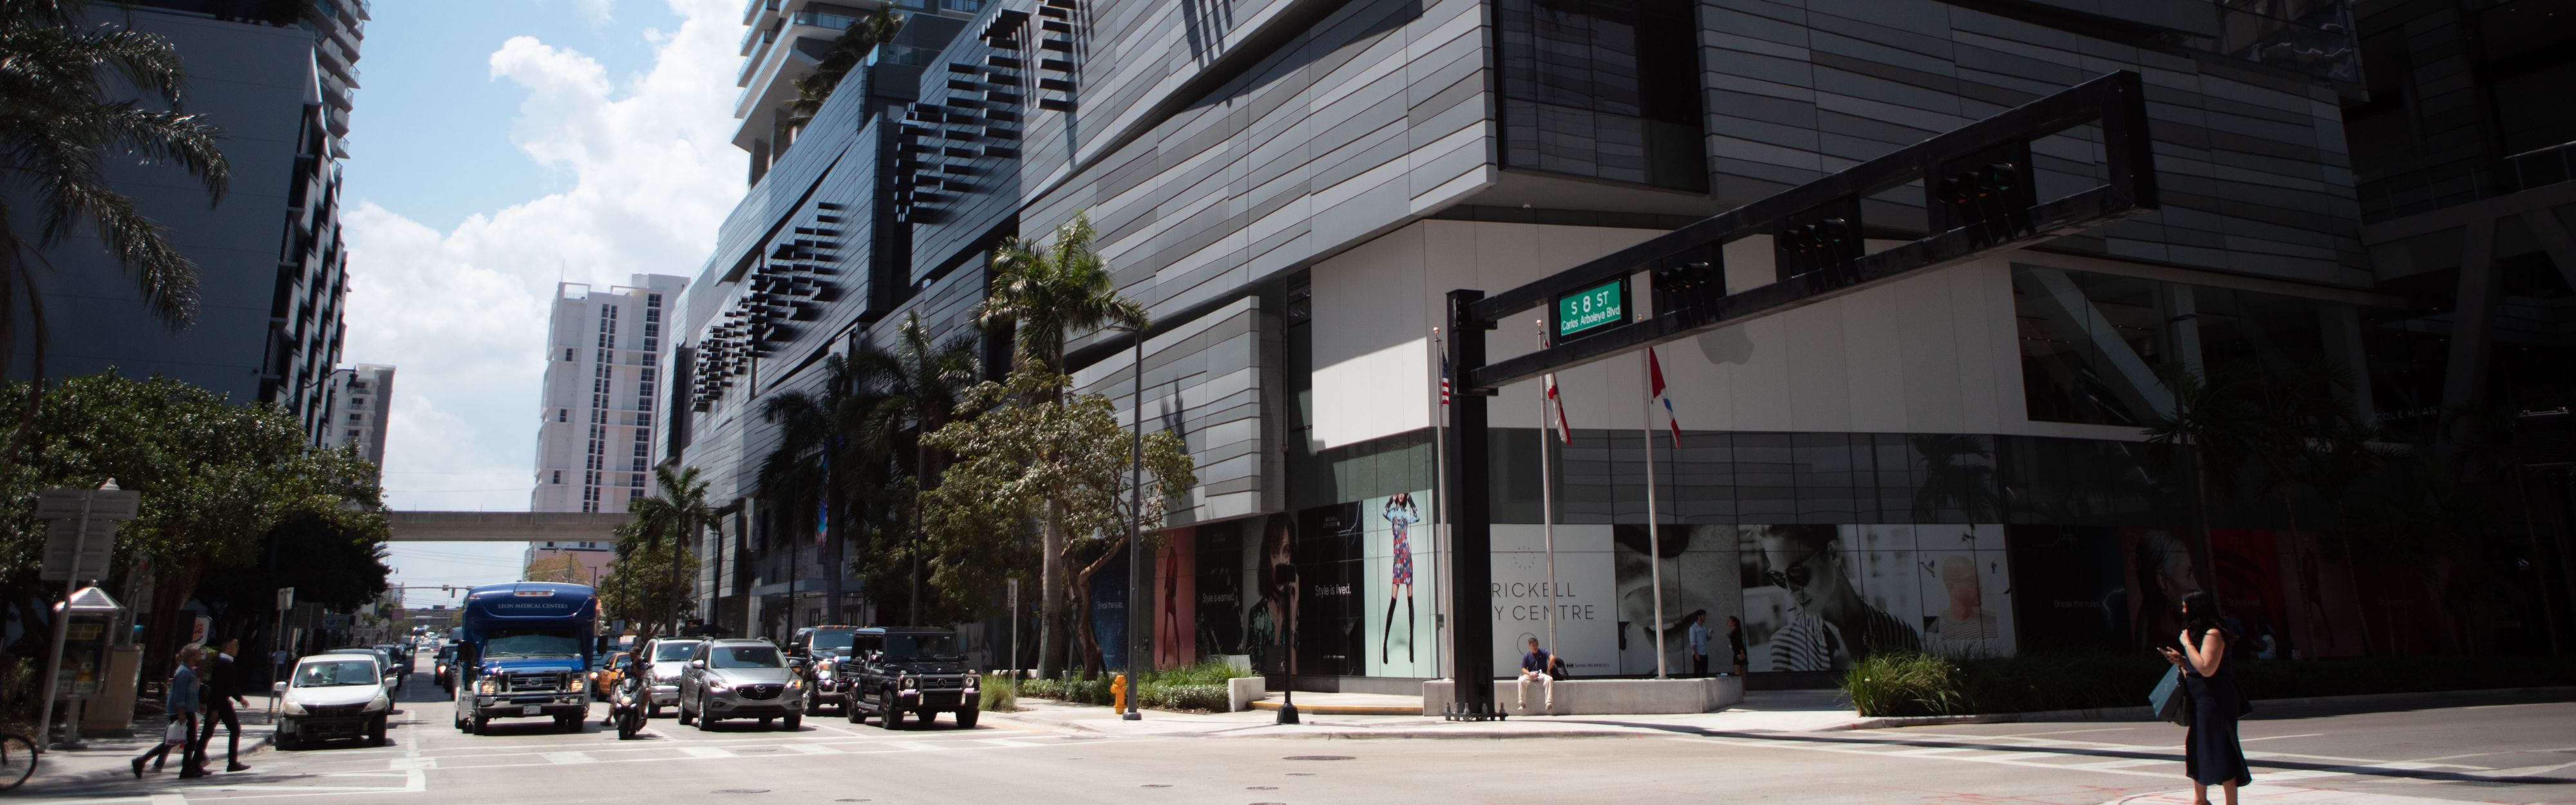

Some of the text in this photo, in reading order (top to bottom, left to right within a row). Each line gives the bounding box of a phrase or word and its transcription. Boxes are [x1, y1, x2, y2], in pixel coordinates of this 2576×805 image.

[1571, 290, 1609, 315] S 8 ST
[1562, 305, 1621, 331] Carlos Arboleya Blvd
[1315, 582, 1351, 598] Style is lived.
[1492, 582, 1576, 598] RICKELL
[1513, 605, 1594, 620] CENTRE
